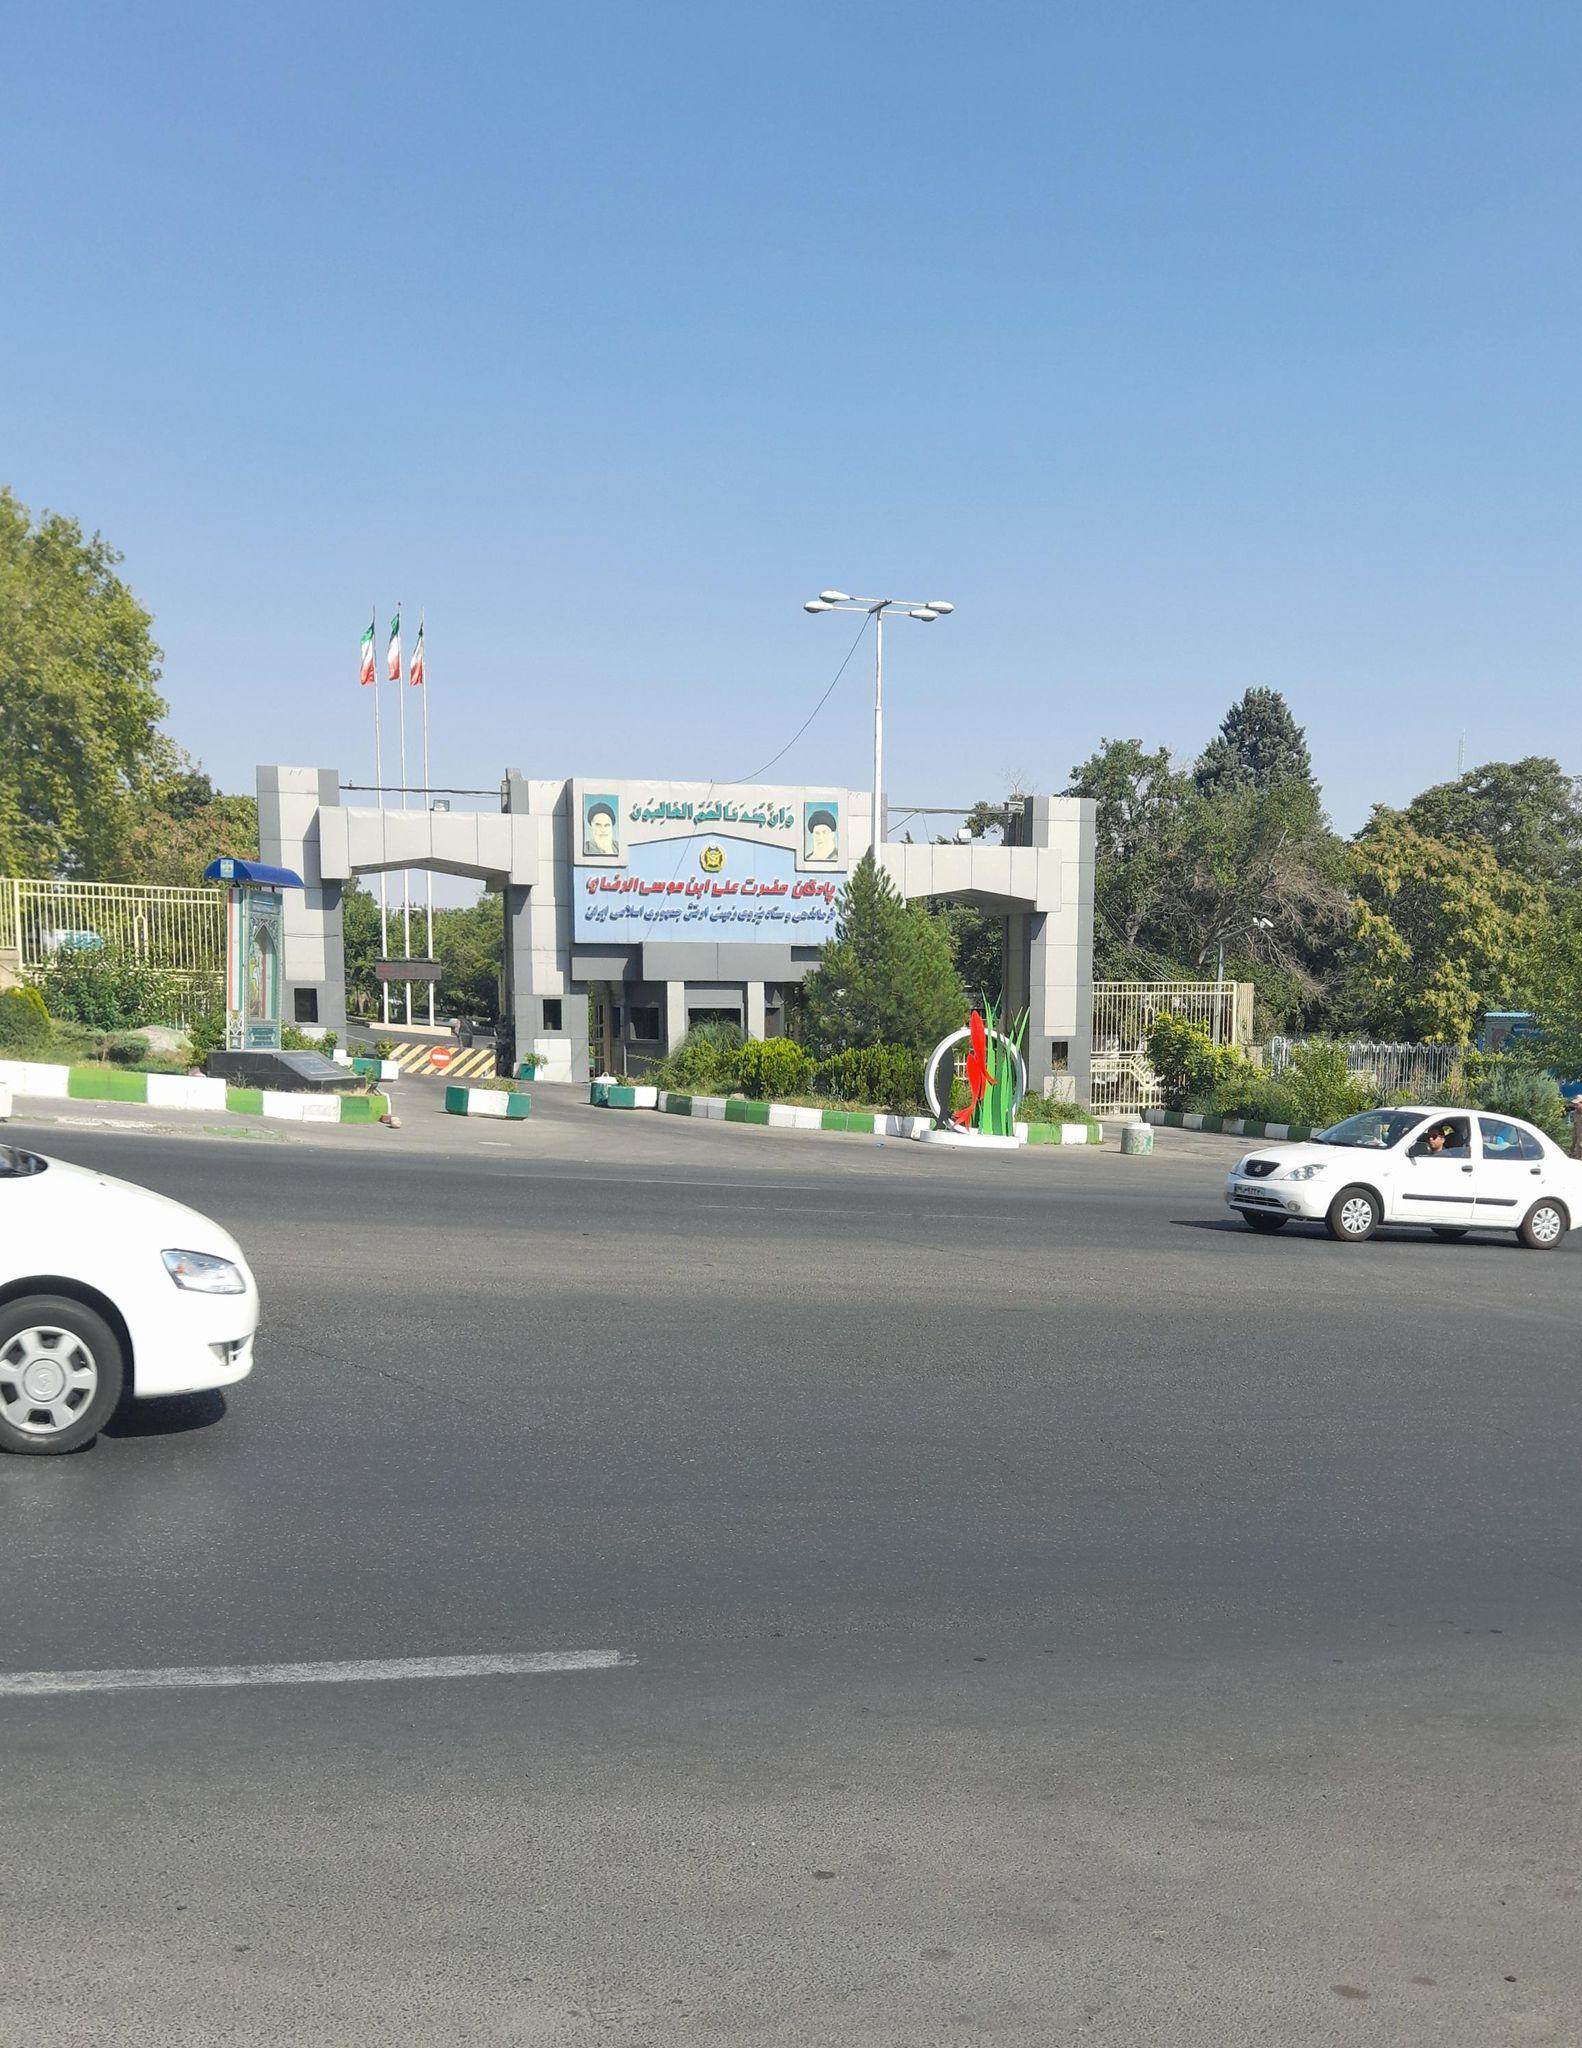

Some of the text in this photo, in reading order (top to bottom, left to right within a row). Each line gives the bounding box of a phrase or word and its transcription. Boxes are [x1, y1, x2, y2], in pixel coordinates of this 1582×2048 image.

[685, 876, 711, 900] ابن
[740, 878, 789, 897] حضرت
[584, 905, 609, 923] ایران
[609, 905, 645, 921] اسلامی
[643, 908, 683, 923] جمهوری
[683, 902, 710, 922] ارتش
[737, 905, 765, 925] نیروی
[791, 905, 837, 924] فرماندهی
